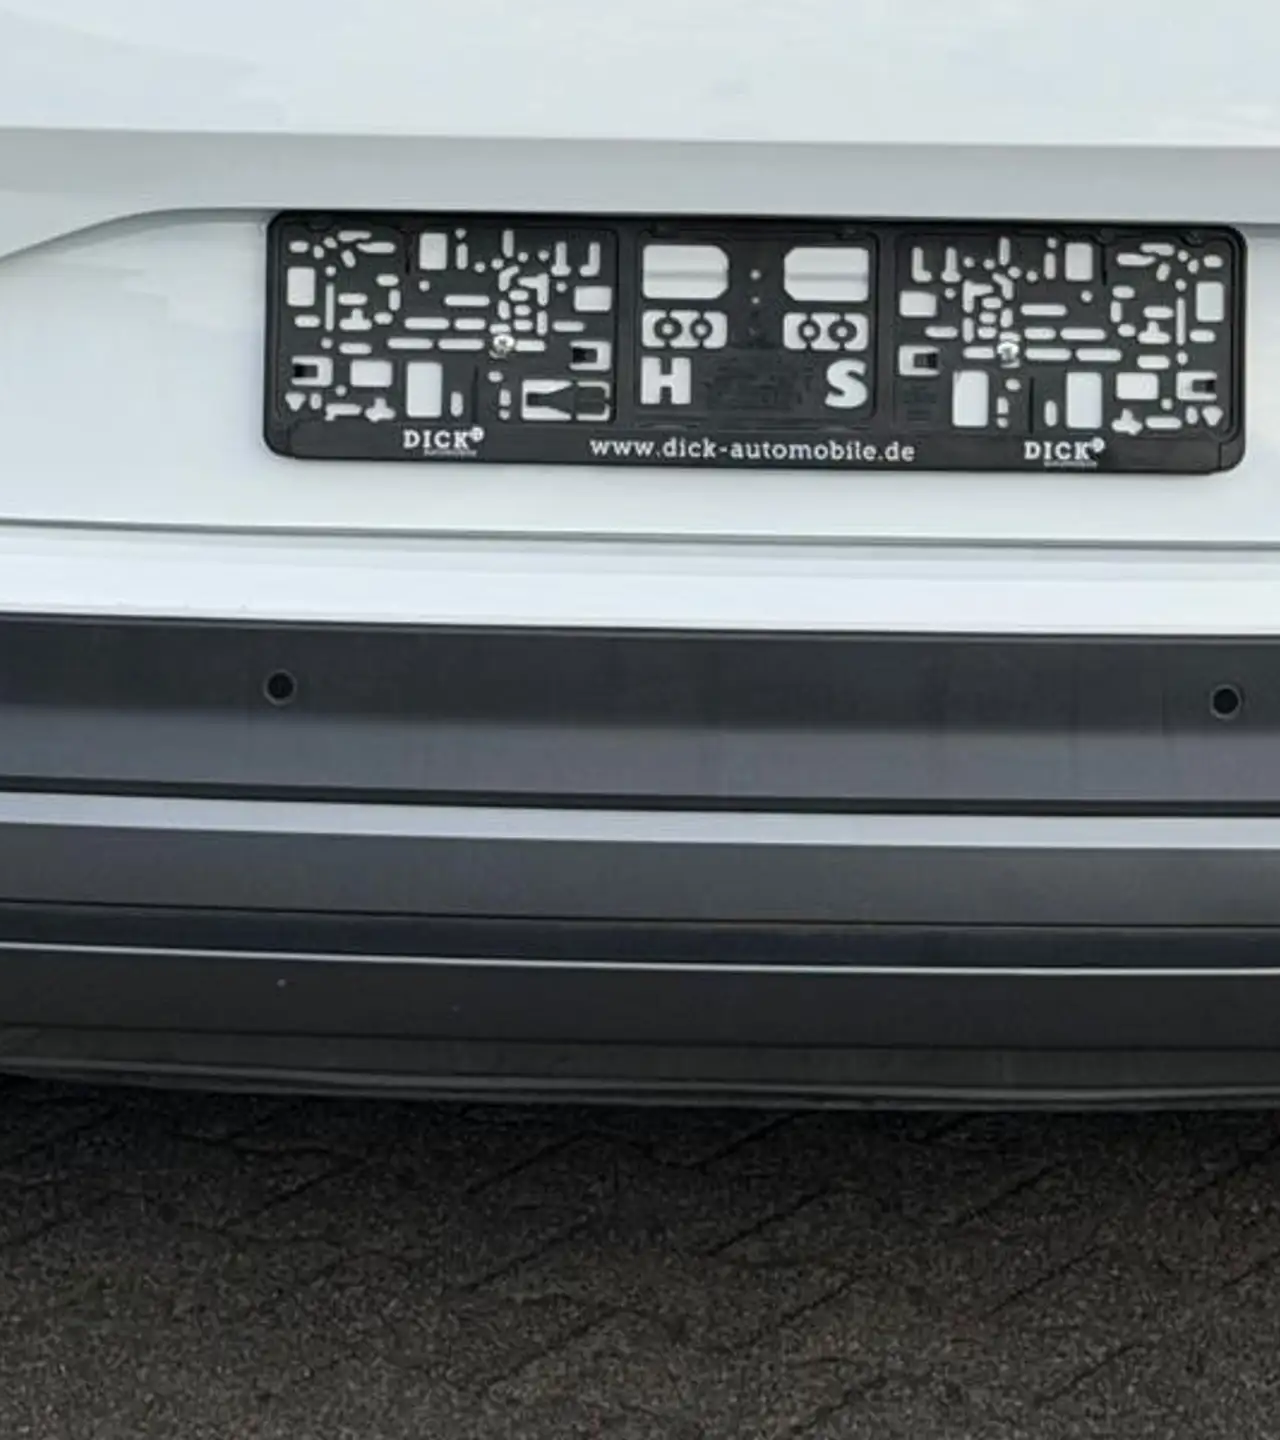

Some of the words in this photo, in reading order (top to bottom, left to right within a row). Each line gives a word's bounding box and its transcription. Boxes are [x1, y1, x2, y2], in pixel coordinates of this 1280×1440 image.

[402, 429, 470, 450] DICK
[589, 437, 917, 462] www.dick-automobile.de
[1024, 441, 1091, 461] DICK
